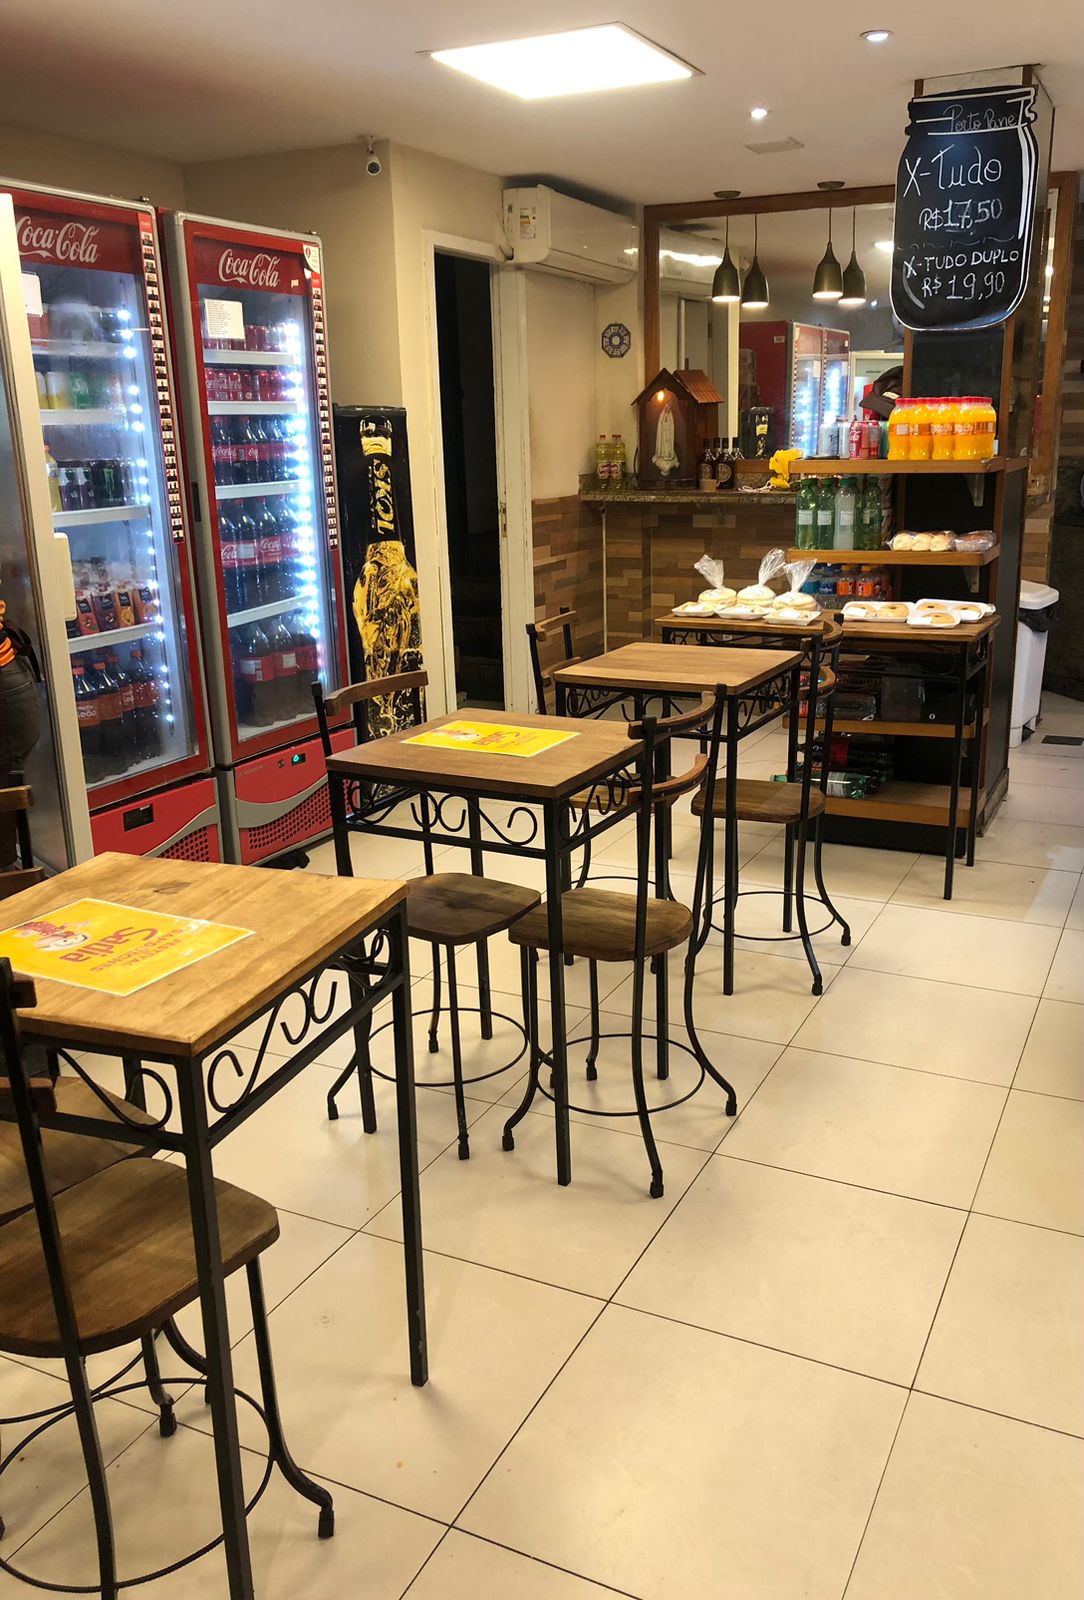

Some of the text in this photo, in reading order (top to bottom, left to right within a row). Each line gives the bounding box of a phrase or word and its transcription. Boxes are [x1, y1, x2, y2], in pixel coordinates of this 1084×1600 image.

[943, 104, 1016, 132] Porto Pane
[903, 144, 1002, 198] X-Tudo
[218, 248, 281, 288] Coca-Cola
[903, 249, 1019, 278] X-TUDO DUPLO
[947, 271, 1005, 300] 19,90
[373, 459, 395, 535] SKOL
[59, 926, 158, 963] Sadia
